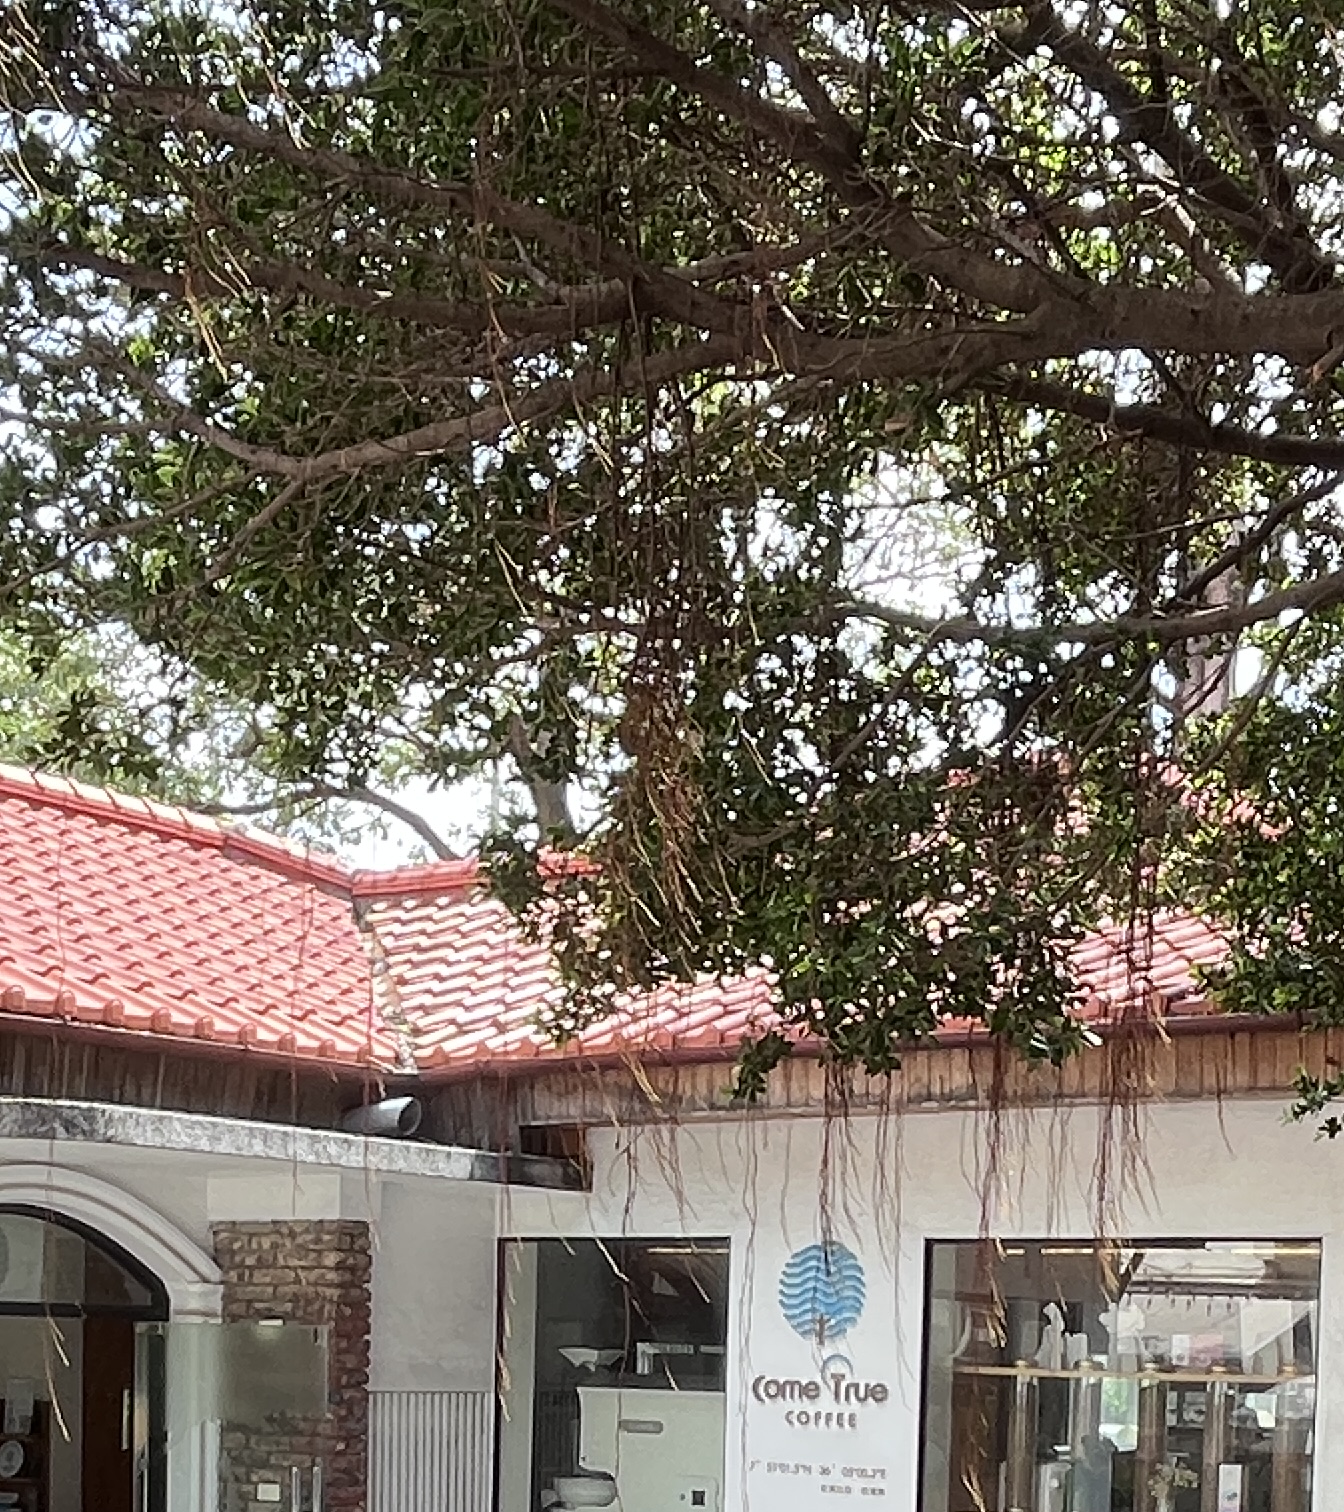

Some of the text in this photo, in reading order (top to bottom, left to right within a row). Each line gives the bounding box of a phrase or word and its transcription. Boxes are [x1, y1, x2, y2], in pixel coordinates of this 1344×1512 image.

[752, 1372, 890, 1404] Come True
[784, 1410, 858, 1430] COFFEE
